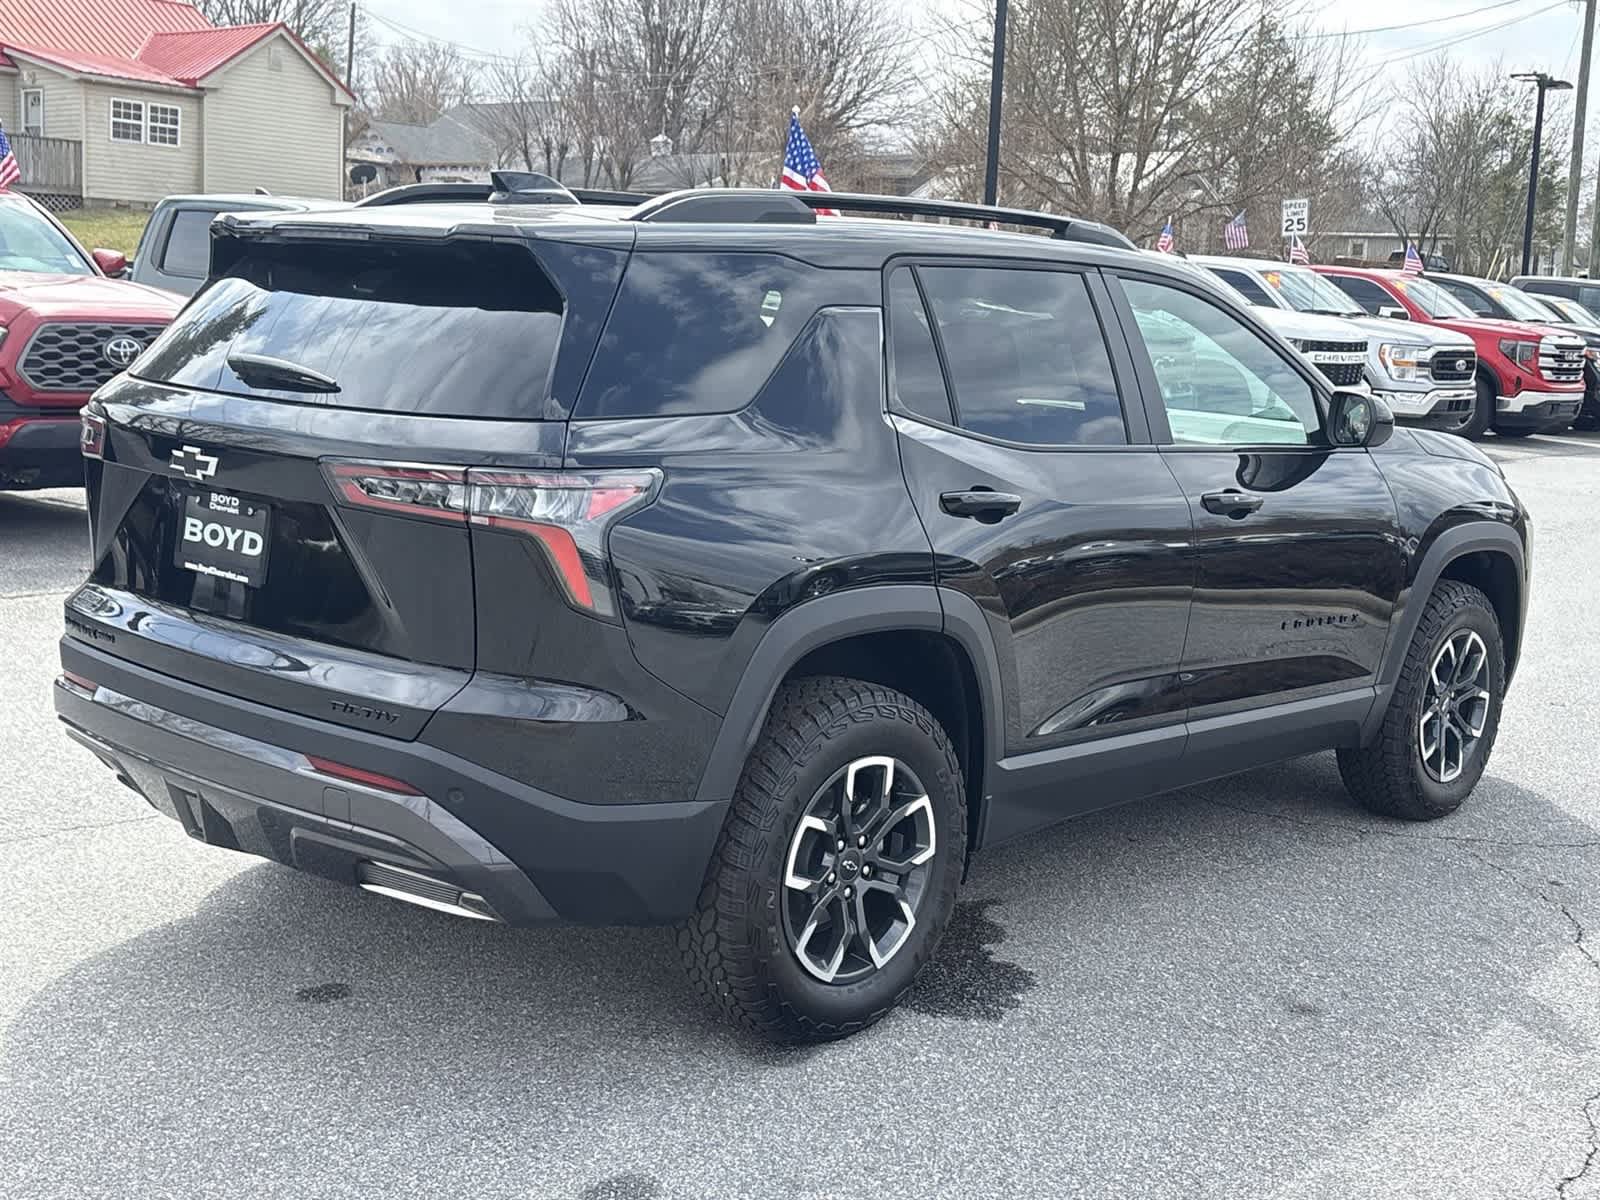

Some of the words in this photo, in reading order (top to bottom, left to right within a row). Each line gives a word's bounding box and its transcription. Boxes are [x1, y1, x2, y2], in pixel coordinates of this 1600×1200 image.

[1284, 218, 1306, 232] 25
[210, 492, 240, 506] BOYD
[183, 516, 264, 556] BOYD
